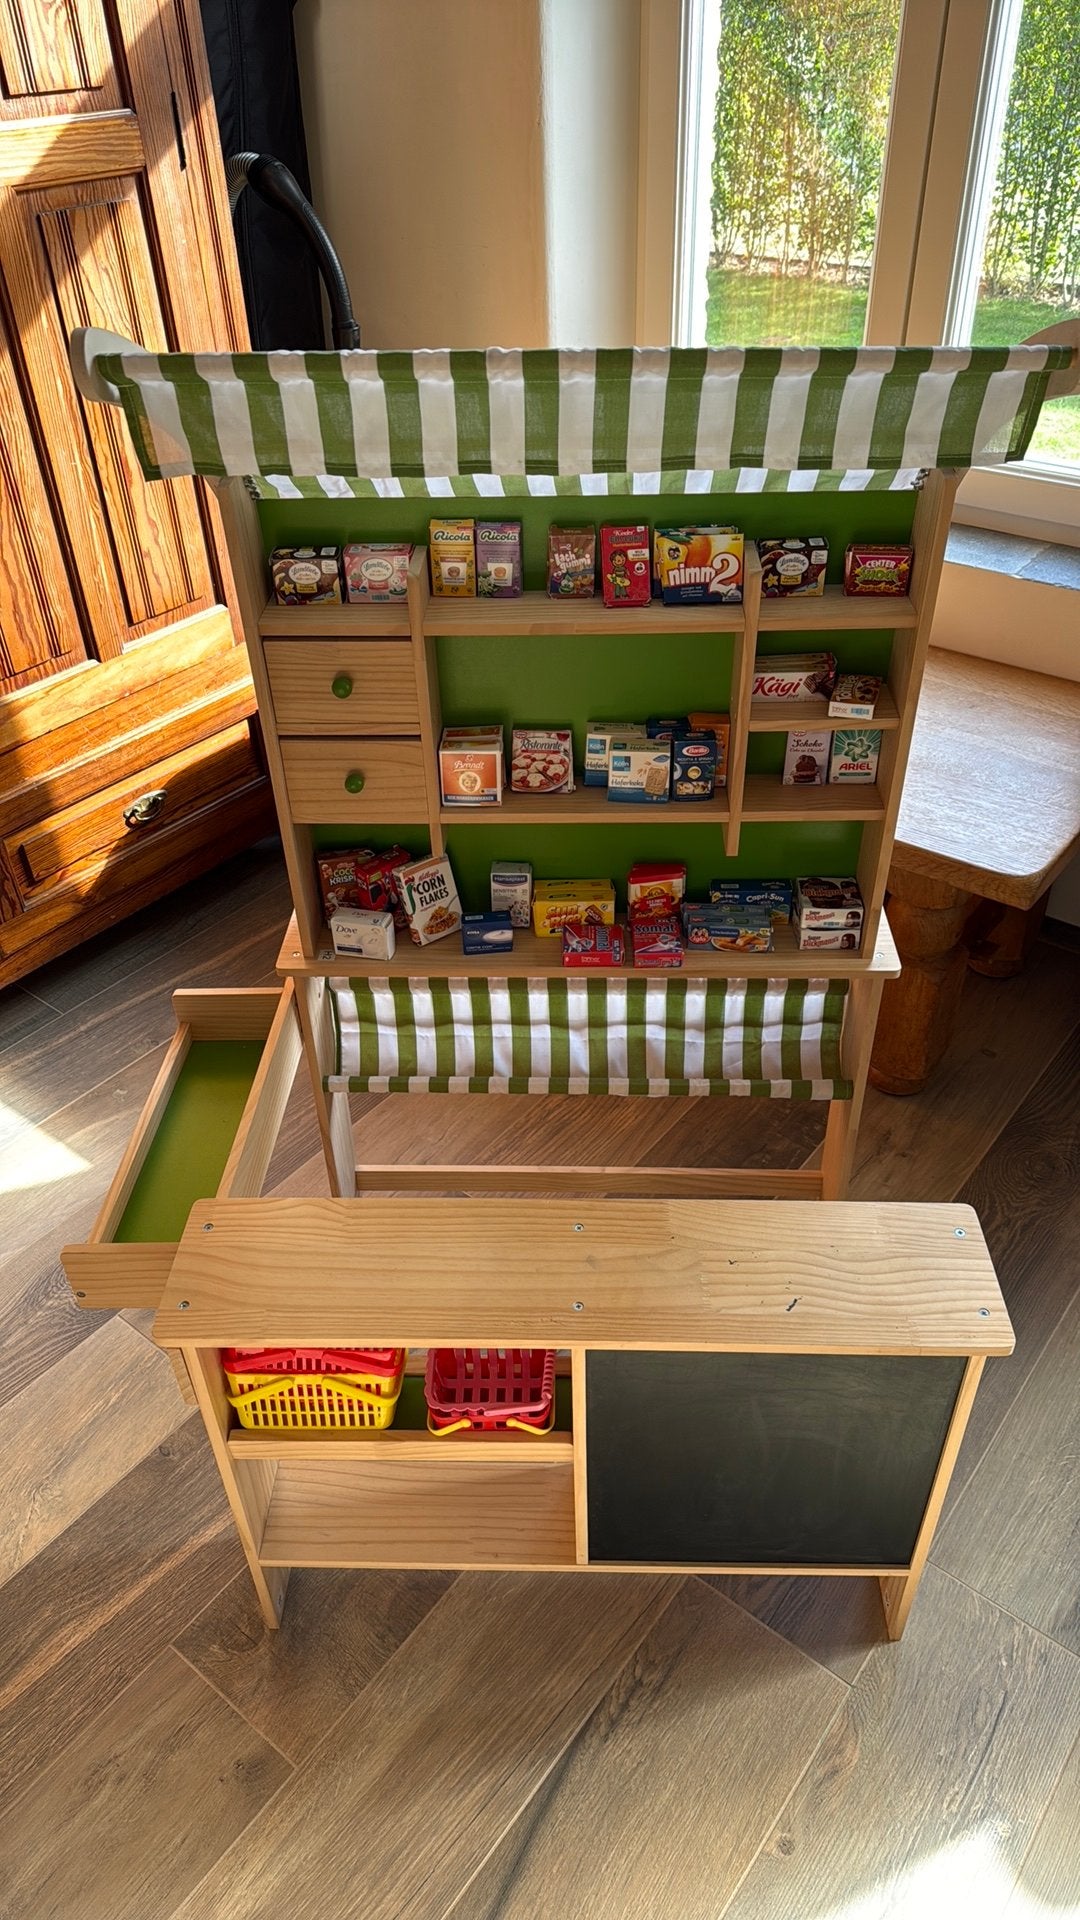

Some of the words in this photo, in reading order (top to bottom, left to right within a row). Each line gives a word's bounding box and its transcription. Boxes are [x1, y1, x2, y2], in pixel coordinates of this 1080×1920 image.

[434, 530, 471, 541] Ricola
[480, 530, 518, 541] Ricola
[554, 551, 576, 566] lach
[560, 554, 591, 573] gummi
[866, 559, 896, 569] CENTER
[752, 676, 803, 698] Kägi
[520, 740, 563, 750] Ristorante
[791, 739, 823, 748] Schoko
[454, 760, 485, 770] Brandt
[838, 763, 872, 771] ARIEL
[611, 778, 644, 788] Haferkeks
[416, 874, 446, 895] CORN
[419, 887, 450, 908] FLAKES
[746, 892, 785, 903] Capri-Sun
[335, 924, 358, 934] Dove
[803, 936, 839, 947] Dickmann's
